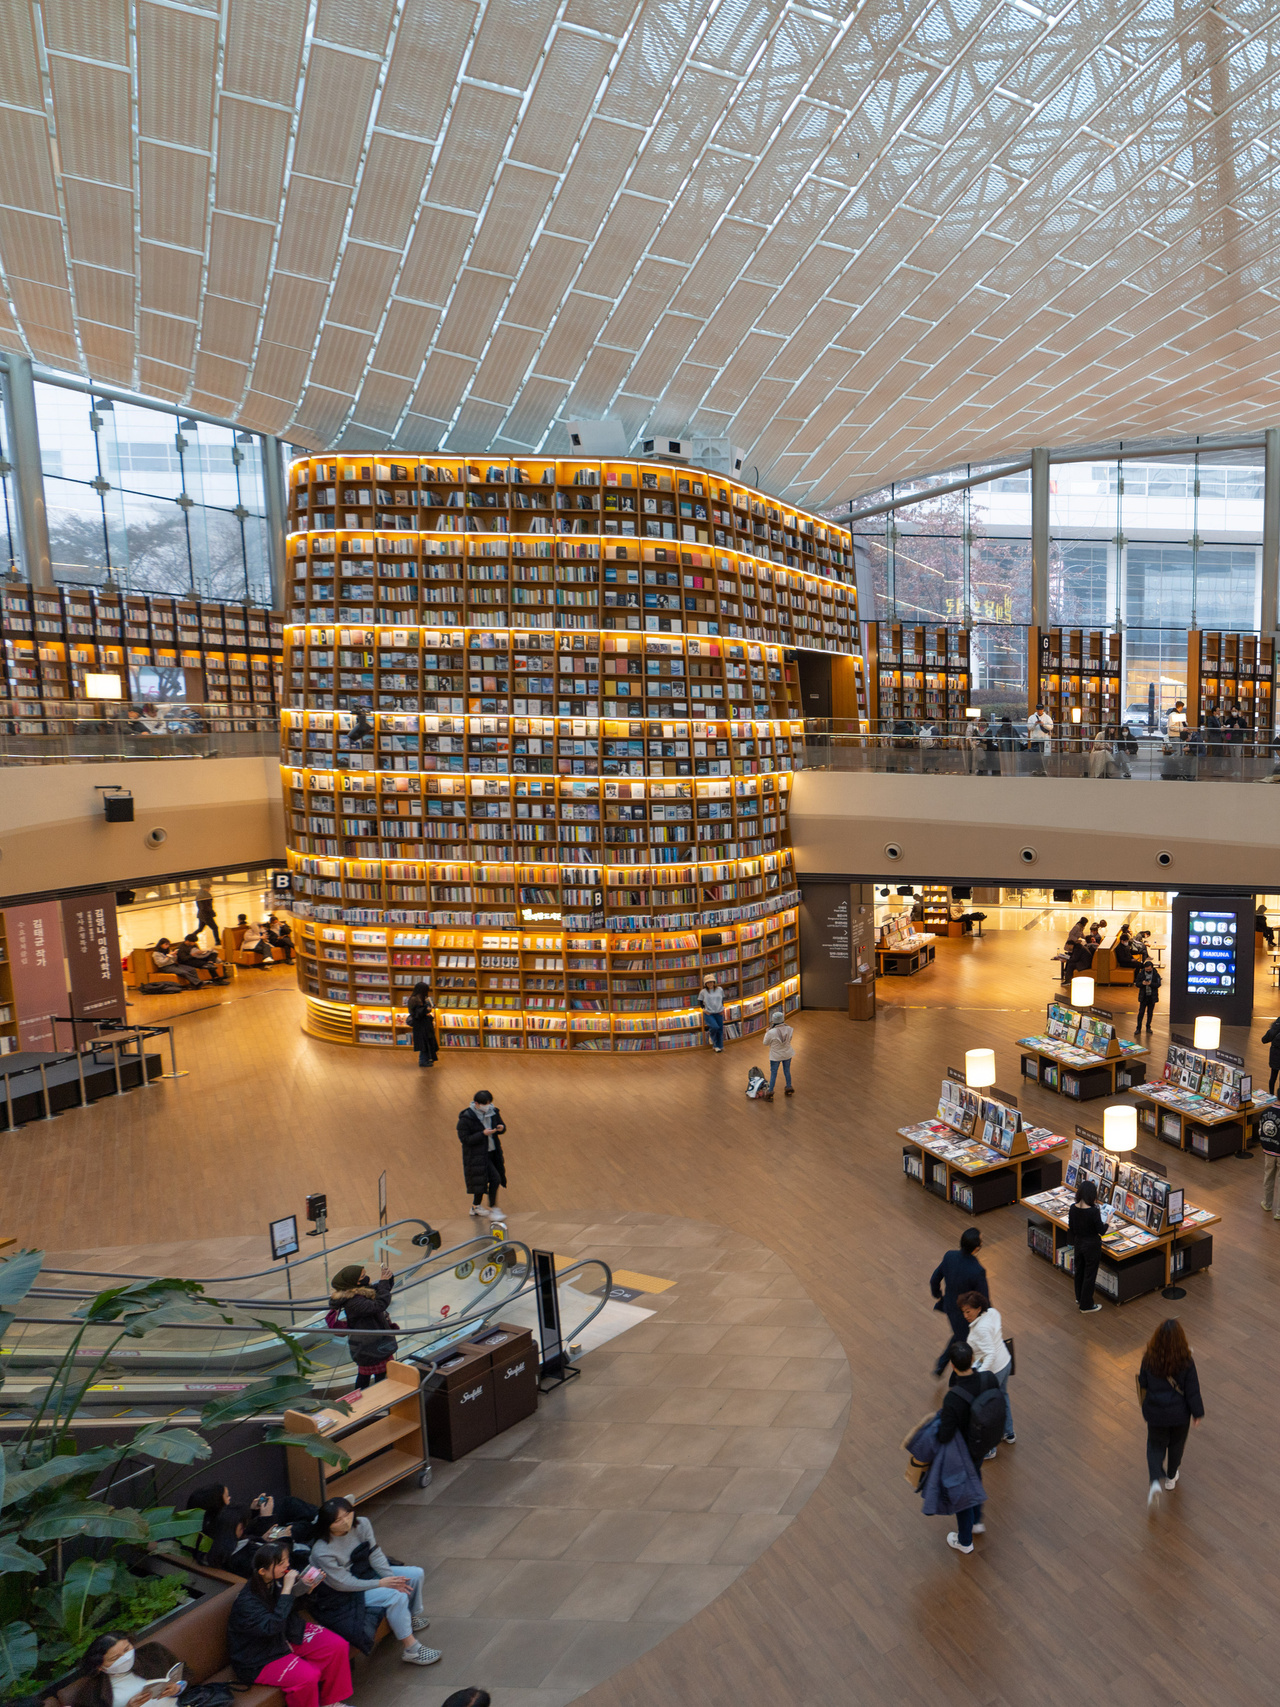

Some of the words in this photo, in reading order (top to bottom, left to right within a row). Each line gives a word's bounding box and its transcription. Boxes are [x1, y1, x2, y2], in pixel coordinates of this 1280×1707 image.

[1043, 637, 1049, 649] G
[276, 875, 290, 888] B
[594, 892, 602, 906] B
[504, 1361, 525, 1380] Starfield
[460, 1385, 483, 1404] Starfield
